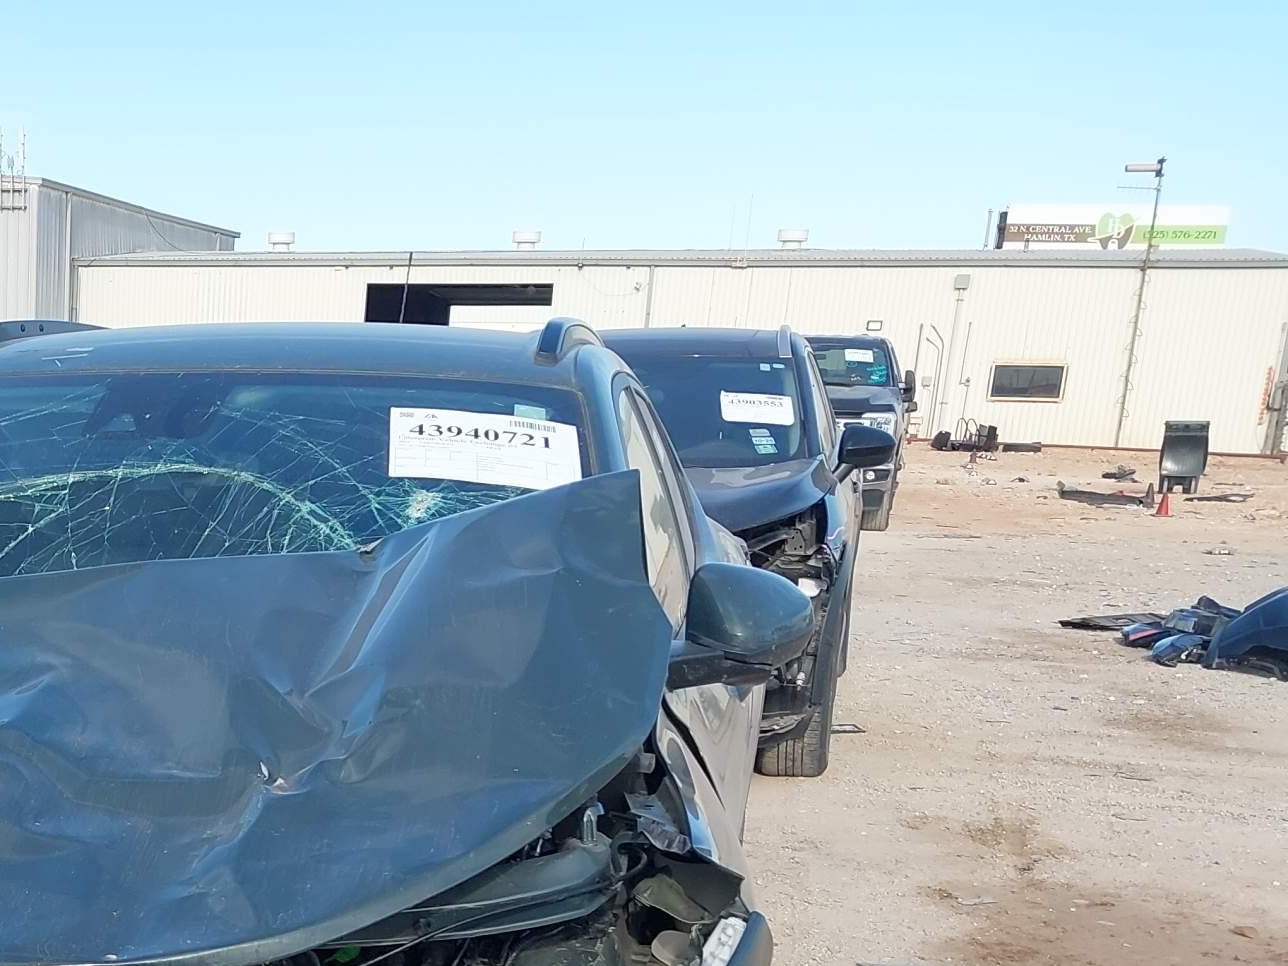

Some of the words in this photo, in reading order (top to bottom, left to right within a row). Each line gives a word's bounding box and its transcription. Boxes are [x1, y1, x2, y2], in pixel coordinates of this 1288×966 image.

[1029, 225, 1071, 234] CENTRAL
[1063, 234, 1076, 242] TX
[1171, 230, 1217, 239] 576-2271
[409, 423, 552, 449] 43940721
